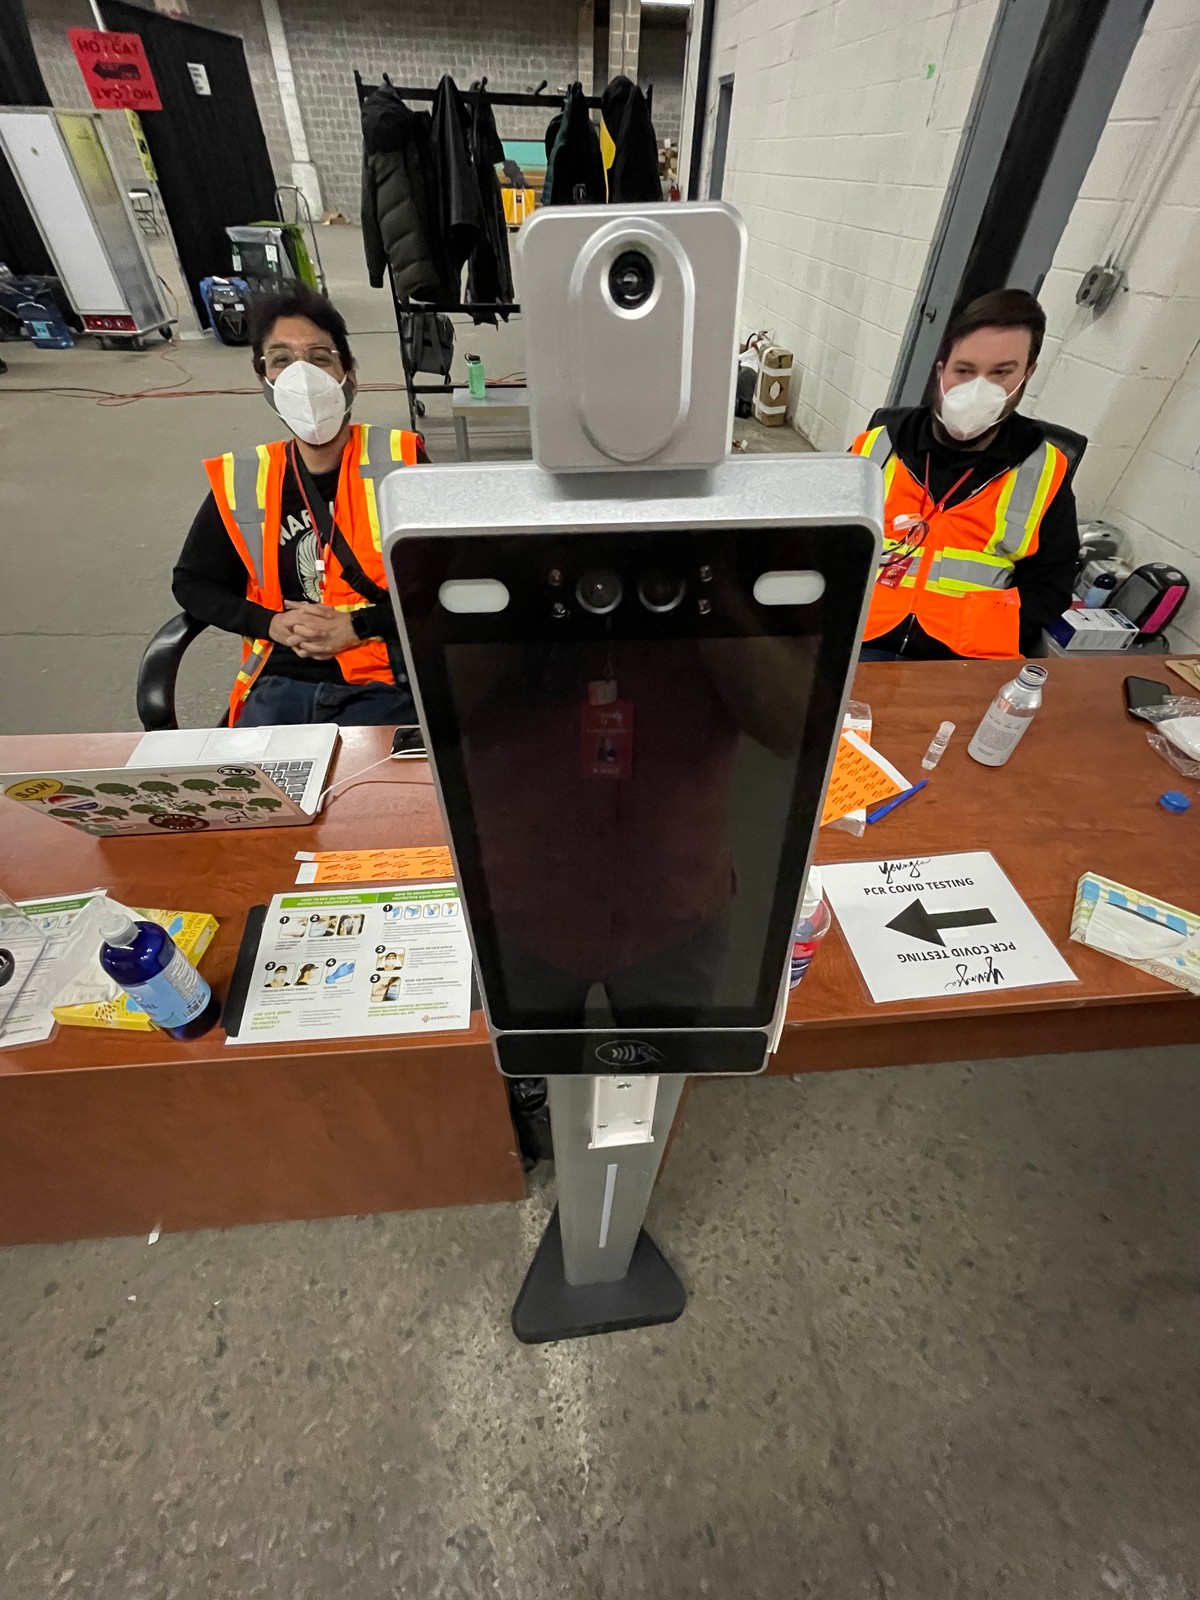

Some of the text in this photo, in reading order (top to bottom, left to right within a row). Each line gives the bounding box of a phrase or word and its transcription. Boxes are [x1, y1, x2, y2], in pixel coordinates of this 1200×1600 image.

[15, 781, 55, 799] S.O.W.
[863, 878, 975, 896] PCR COVID TESTING
[897, 941, 1017, 963] PCR COVID TESTING
